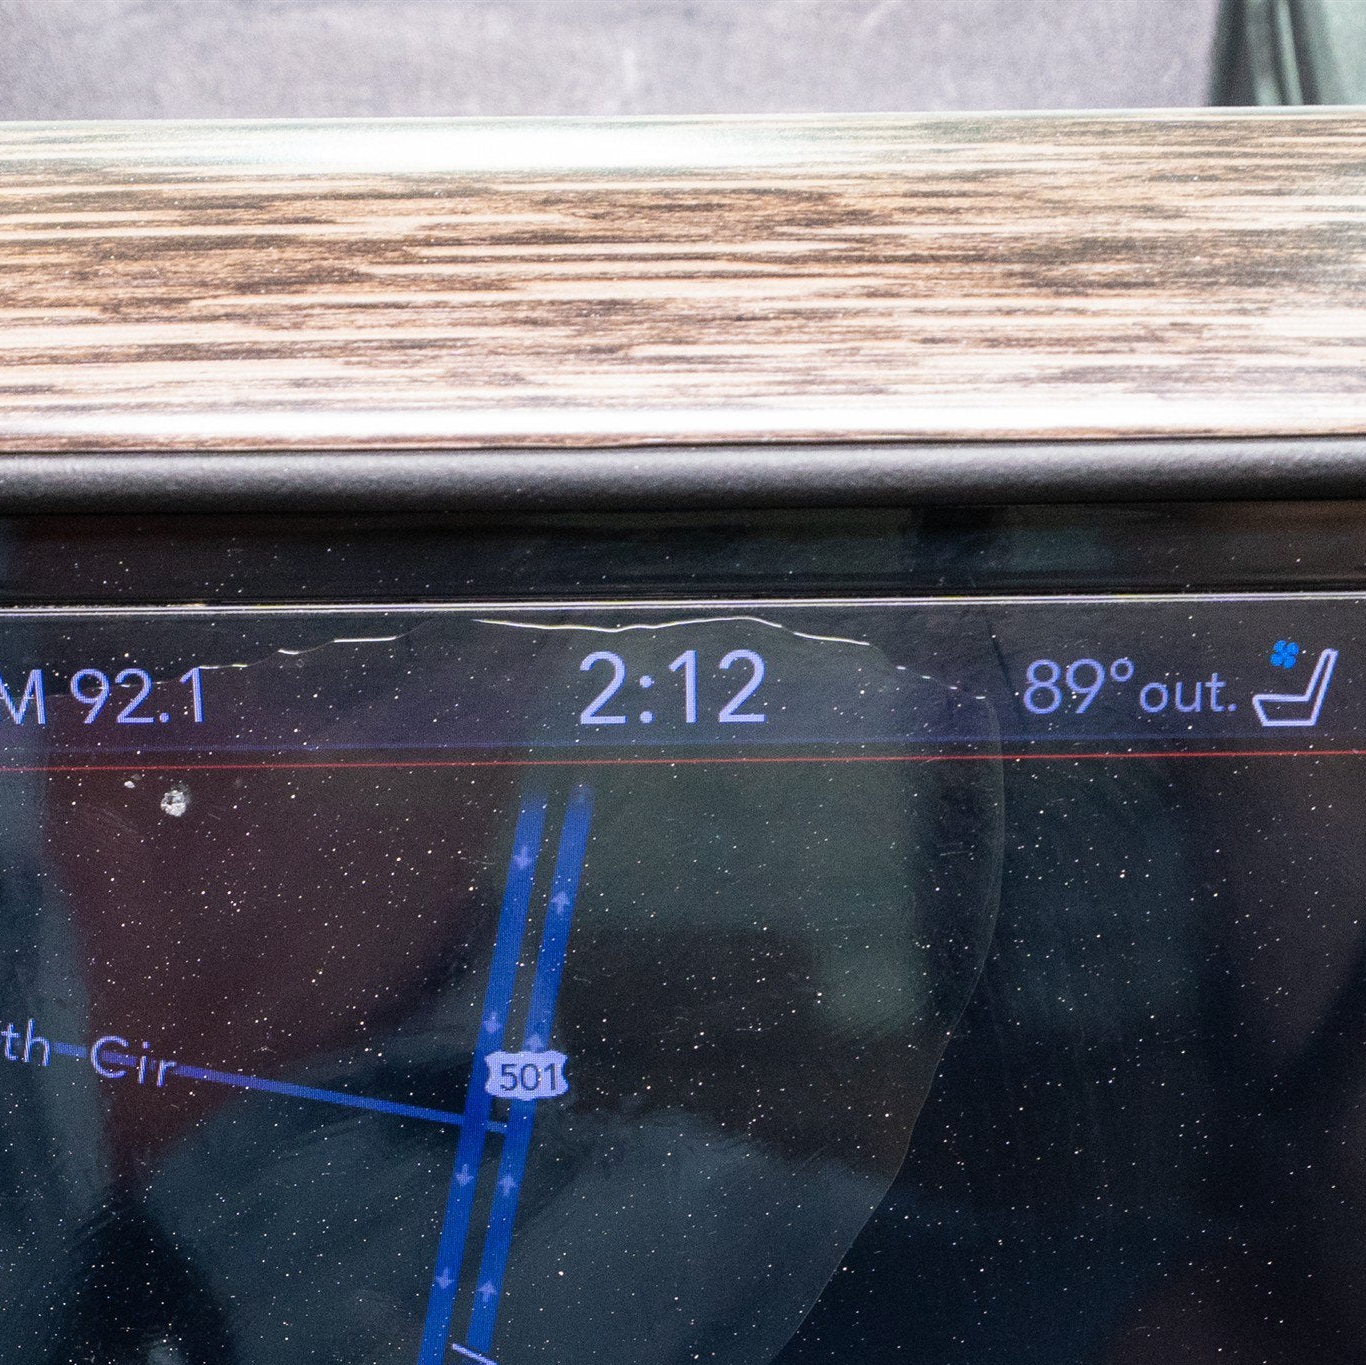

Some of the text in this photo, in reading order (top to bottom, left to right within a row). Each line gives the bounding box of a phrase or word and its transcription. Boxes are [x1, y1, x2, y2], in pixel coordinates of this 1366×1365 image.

[69, 667, 205, 725] 92.1
[579, 650, 767, 724] 2:12
[1139, 672, 1237, 713] out.
[90, 1034, 177, 1087] Cir
[500, 1063, 556, 1091] 501
